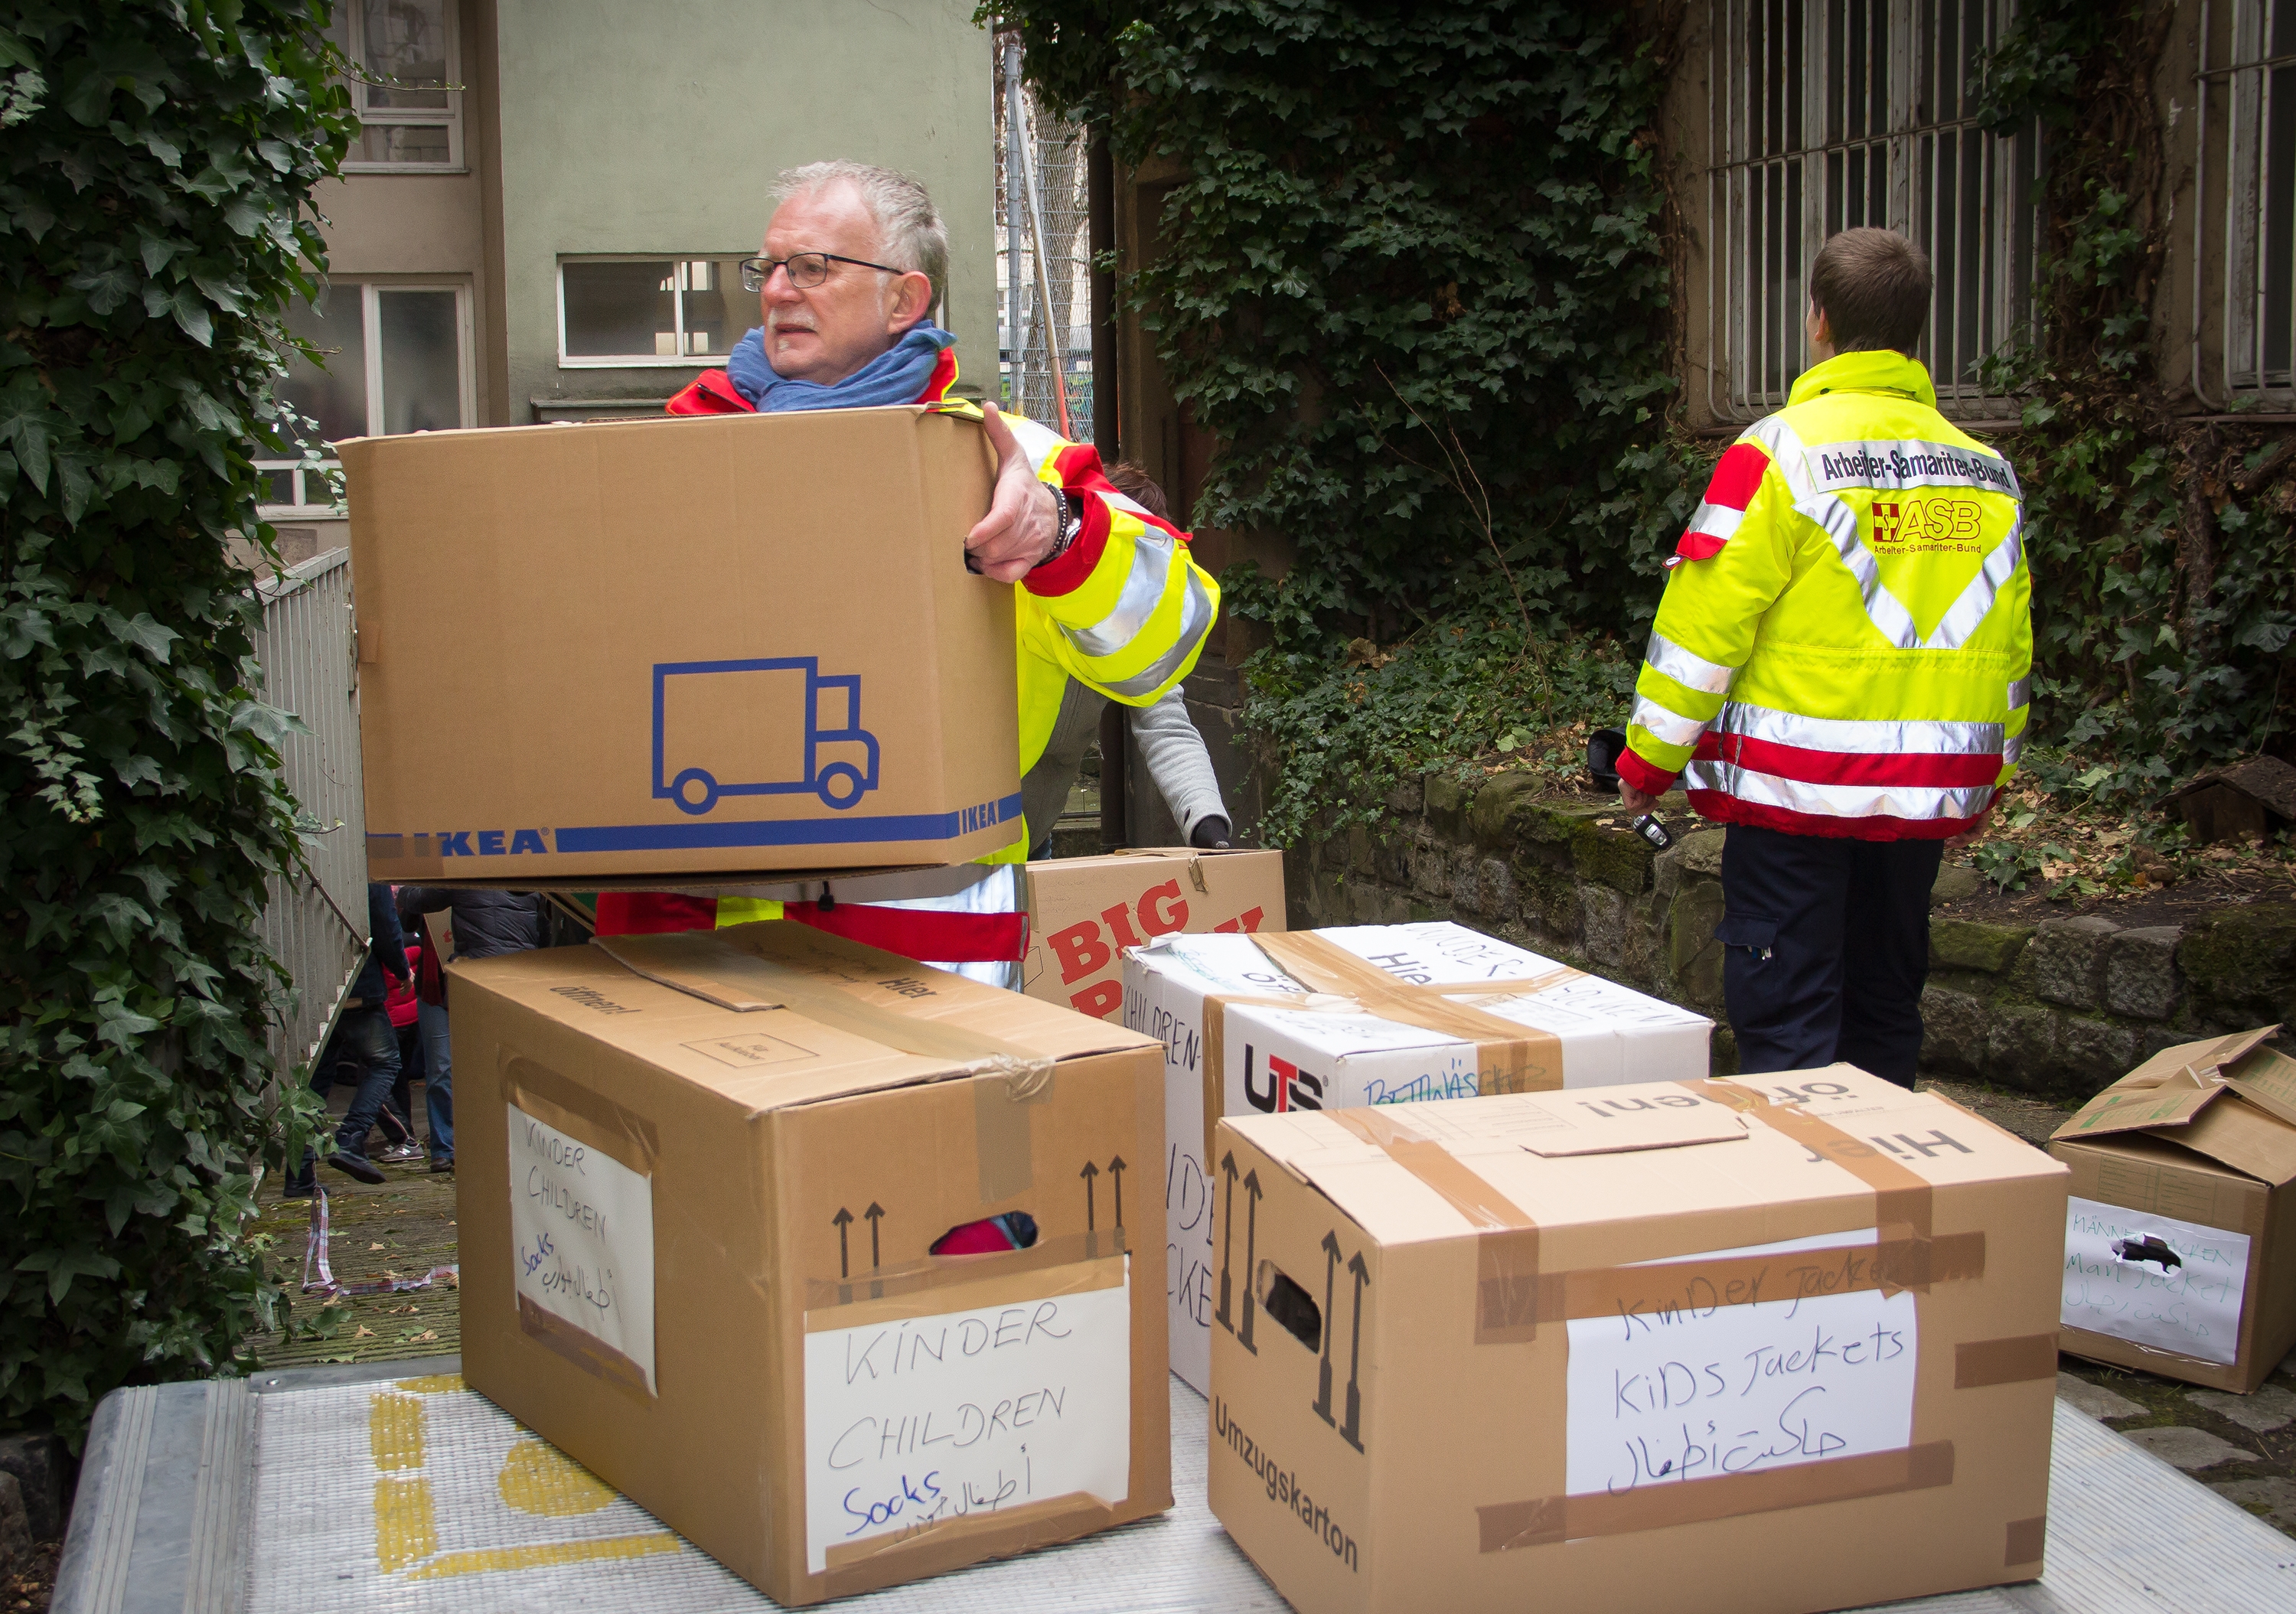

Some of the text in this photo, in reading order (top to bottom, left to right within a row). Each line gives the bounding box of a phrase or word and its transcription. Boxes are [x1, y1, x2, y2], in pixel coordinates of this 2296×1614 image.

[1821, 448, 2014, 490] Arbeiter-Samariter-Bund
[1893, 497, 1981, 542] ASB
[1874, 543, 1981, 555] Arbeiter-Samariter-Bund
[961, 800, 997, 835] IKEA
[1046, 878, 1189, 986] BIG
[877, 977, 938, 999] Hier
[1367, 952, 1433, 985] Hie
[550, 986, 642, 1015] öffnen!
[1244, 1043, 1323, 1113] UTS
[1805, 1129, 1975, 1162] Hier
[528, 1165, 607, 1244] CHILDREN
[827, 1385, 1067, 1469] CHILDREN
[1215, 1394, 1358, 1573] Umzugskarton
